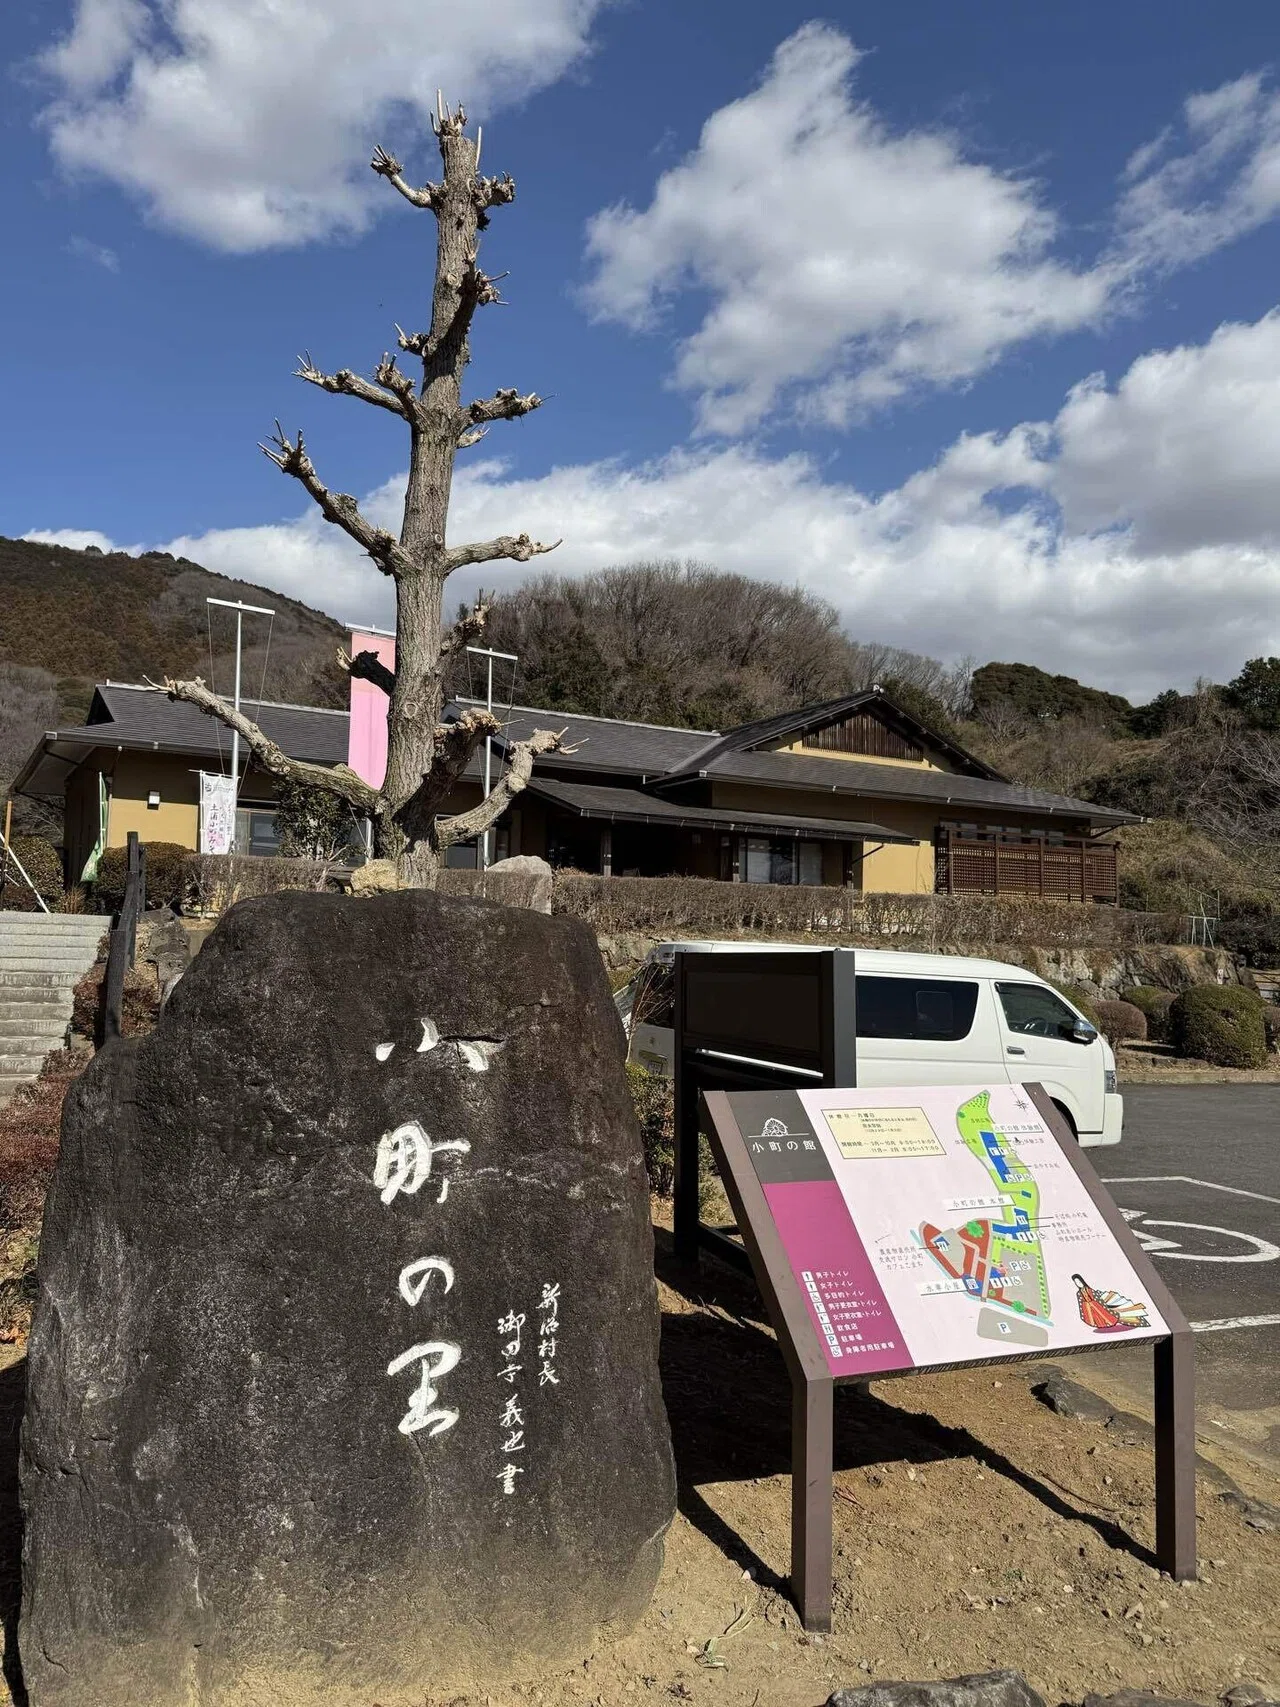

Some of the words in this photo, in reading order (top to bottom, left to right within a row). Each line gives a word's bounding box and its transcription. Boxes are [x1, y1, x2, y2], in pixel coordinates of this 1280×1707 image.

[752, 1139, 817, 1153] 小町の館
[952, 1198, 985, 1208] 小町の館
[372, 1016, 490, 1436] 小町の里
[815, 1271, 850, 1279] 男子トイレ
[820, 1281, 854, 1290] 女子トイレ
[824, 1291, 865, 1300] 多目的トイレ
[837, 1323, 859, 1331] 飲食店
[840, 1334, 863, 1343] 駐車場
